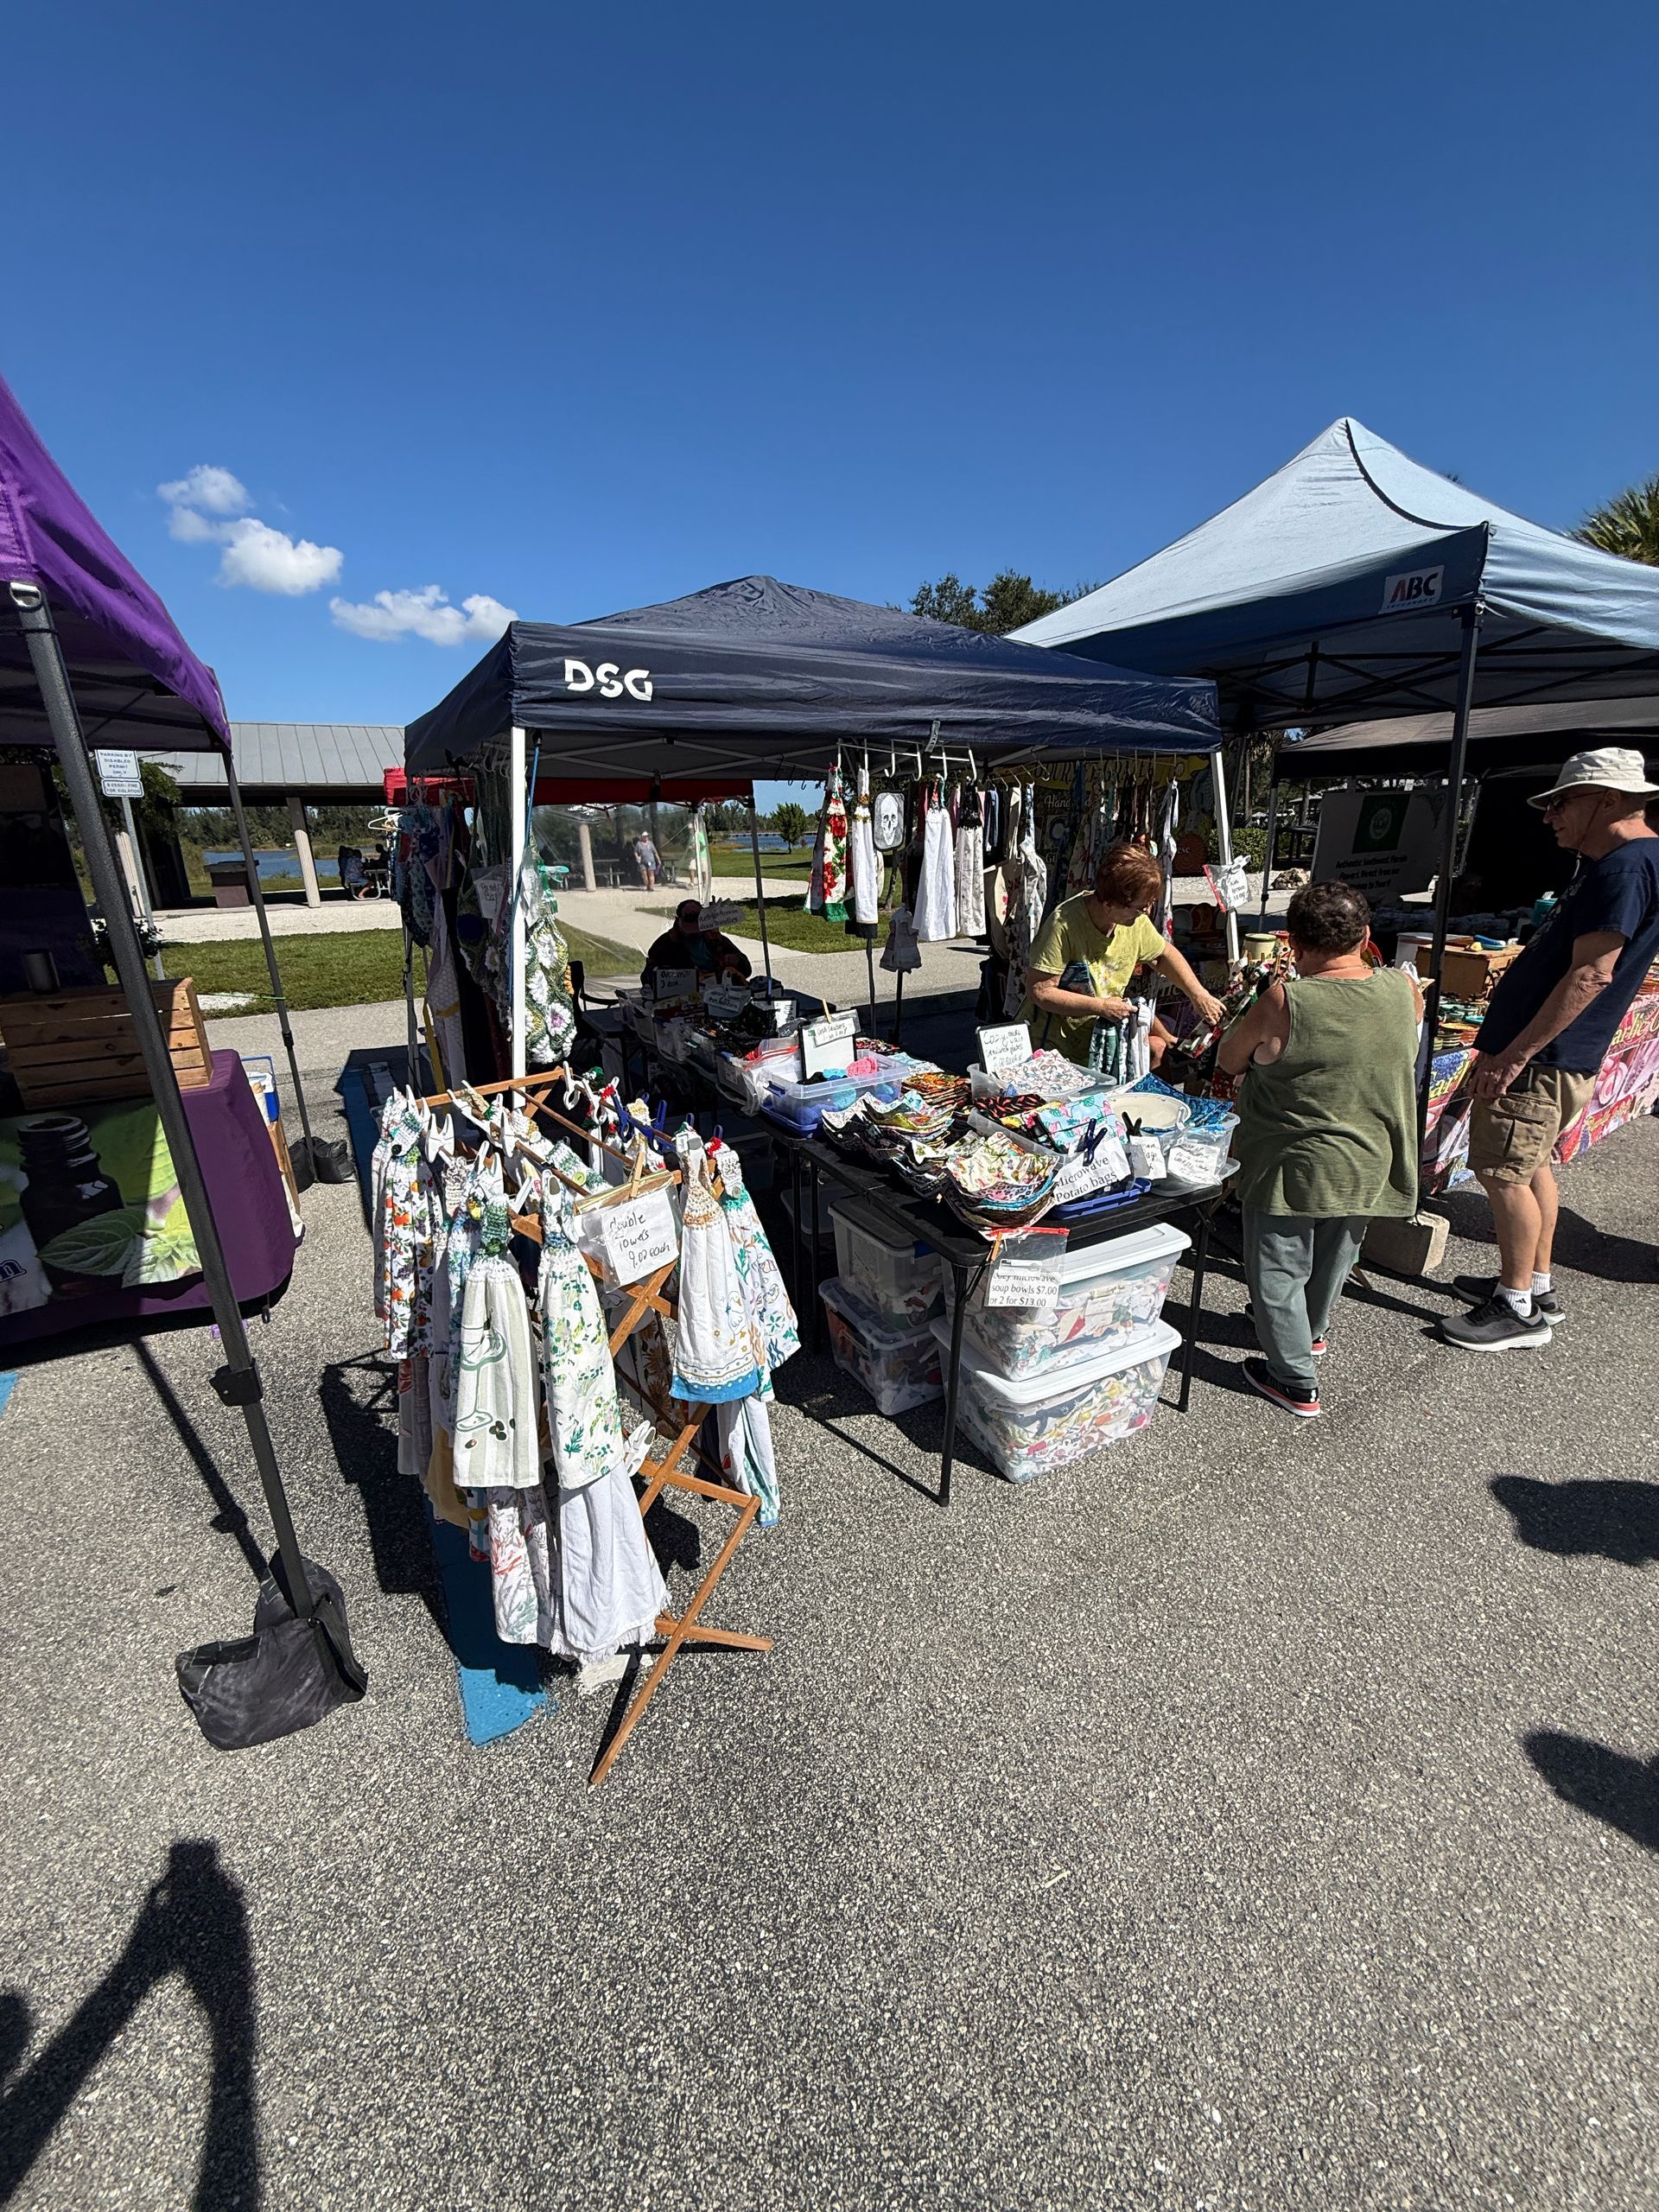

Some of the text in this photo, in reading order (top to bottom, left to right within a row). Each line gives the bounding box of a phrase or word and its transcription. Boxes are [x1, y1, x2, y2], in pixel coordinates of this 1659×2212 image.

[1390, 573, 1440, 603] ABC
[564, 658, 653, 702] DSG
[1057, 1157, 1109, 1186] Microwave
[1055, 1171, 1118, 1203] Potato bags
[991, 1283, 1058, 1295] soup bowls $7.00
[999, 1295, 1004, 1305] 2
[1006, 1295, 1018, 1305] for
[1019, 1296, 1046, 1307] $13.00
